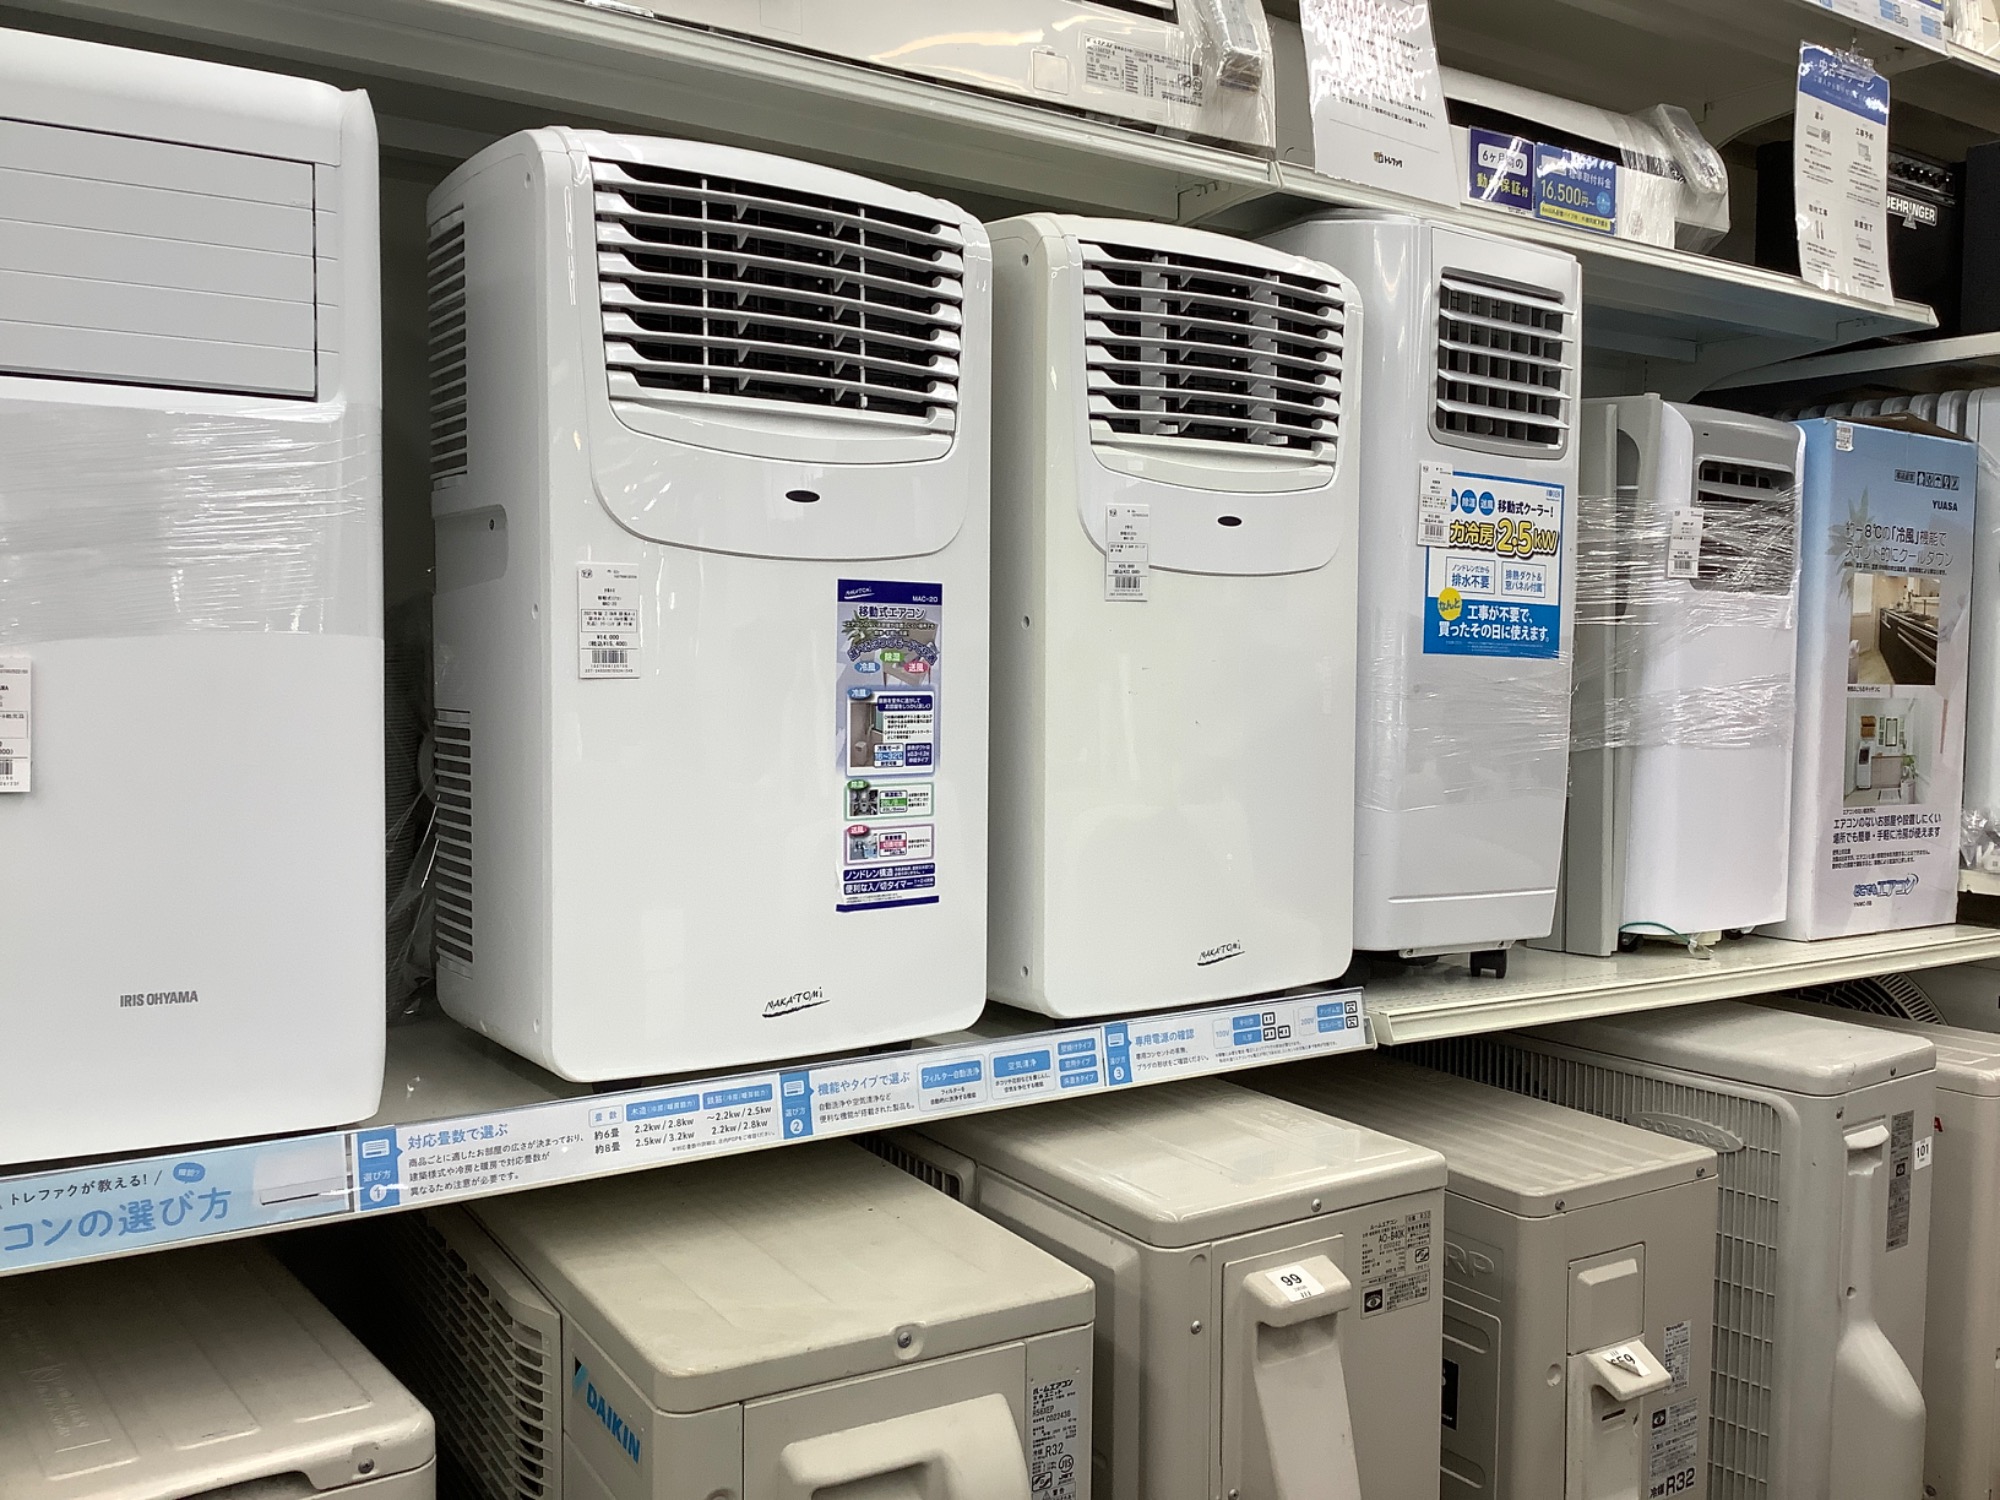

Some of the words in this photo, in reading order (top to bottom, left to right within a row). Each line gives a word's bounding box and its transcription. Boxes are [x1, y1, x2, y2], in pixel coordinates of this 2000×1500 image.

[1932, 499, 1958, 512] YUASA
[1451, 574, 1490, 589] 排水不要
[912, 595, 938, 603] MAC-20
[858, 605, 926, 619] 移動式エアコン
[1467, 604, 1533, 623] 工事が不要で、
[1438, 621, 1549, 643] 買ったその日に使えます。
[119, 993, 145, 1008] IRIS
[146, 990, 199, 1006] OHYAMA
[1134, 1029, 1195, 1047] 専用電源の確認
[1007, 1058, 1037, 1071] 空気清浄
[817, 1071, 911, 1097] 機能やタイプで選ぶ
[785, 1106, 806, 1118] 選び方
[819, 1101, 915, 1124] 便利な機能が搭載された製品も。
[407, 1123, 509, 1150] 対応畳数で選ぶ
[593, 1127, 620, 1141] 約6畳
[408, 1133, 584, 1168] 商品ごとに適したお部屋の広さが決まっており、
[594, 1141, 621, 1155] 約8畳
[1916, 1144, 1930, 1159] 101
[363, 1169, 391, 1182] 選び方
[409, 1151, 551, 1182] 建築様式や冷房と暖房で対応畳数が
[409, 1172, 520, 1197] 異なるため注意が必要です。
[3, 1186, 233, 1251] コンの選び方
[1280, 1272, 1303, 1287] 99
[586, 1381, 642, 1465] DAIKIN
[1045, 1441, 1064, 1458] R32
[1665, 1467, 1696, 1497] R32
